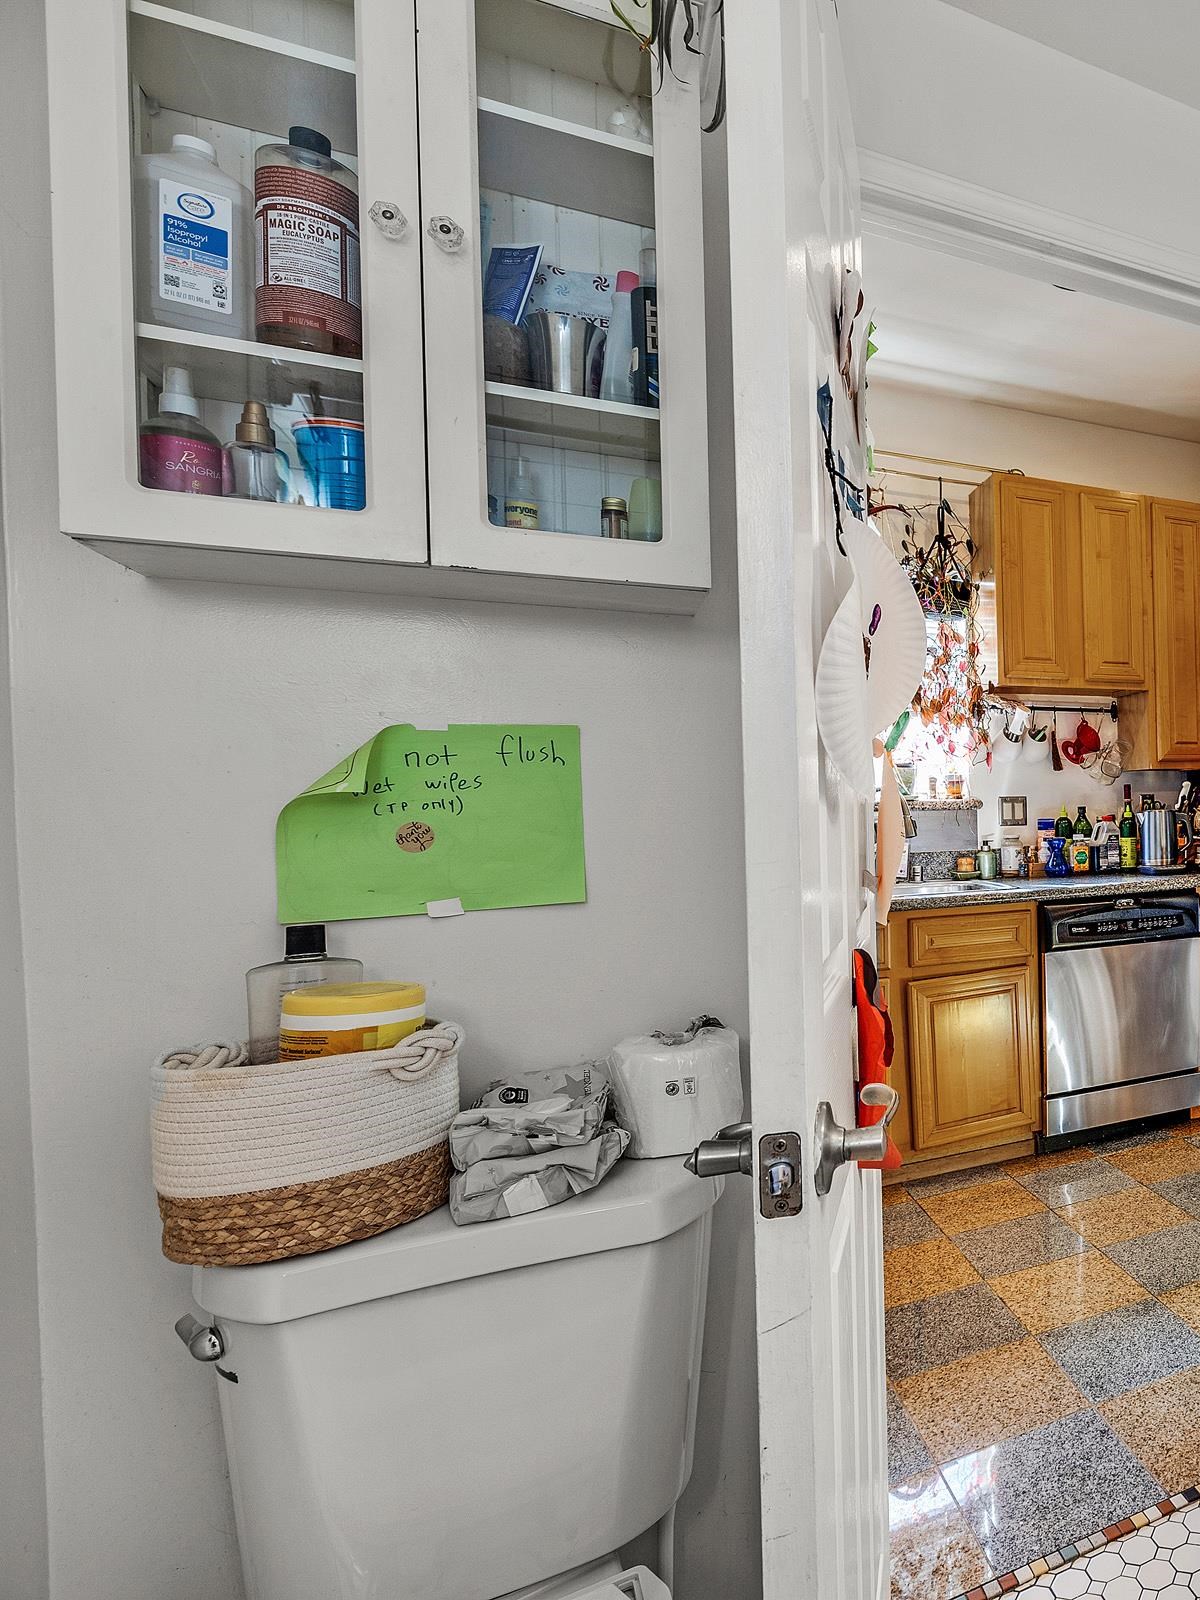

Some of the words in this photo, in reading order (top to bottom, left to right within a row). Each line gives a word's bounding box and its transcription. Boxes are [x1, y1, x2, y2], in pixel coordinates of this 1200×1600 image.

[288, 205, 330, 221] BRONNER'S
[167, 217, 188, 229] 91%
[269, 218, 306, 232] MAGIC
[307, 223, 340, 242] SOAP
[167, 225, 208, 243] Isopropyl
[167, 233, 201, 248] Alcohol
[282, 229, 325, 245] EUCALYPTUS
[165, 461, 221, 480] SANGRIA
[404, 745, 458, 768] not
[496, 734, 566, 767] flush
[424, 771, 483, 791] wipes
[373, 801, 408, 817] (TP
[421, 795, 464, 817] only)
